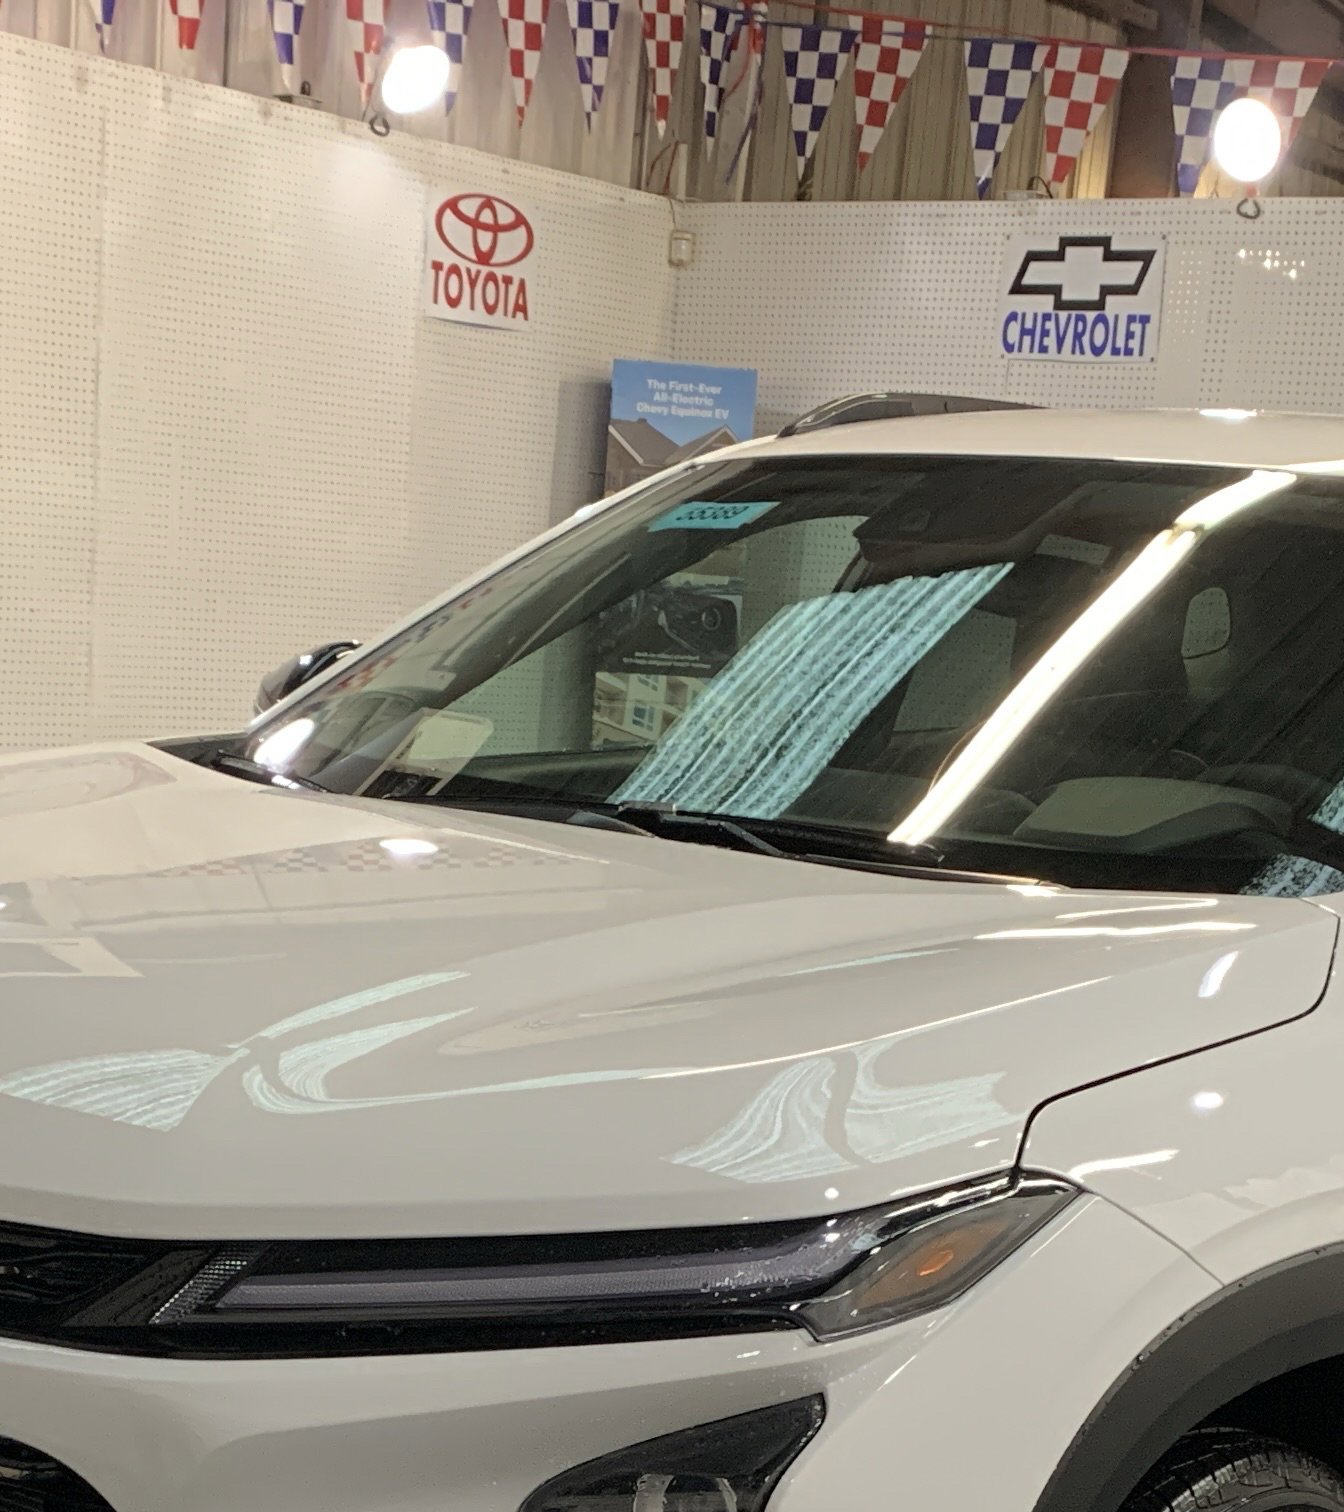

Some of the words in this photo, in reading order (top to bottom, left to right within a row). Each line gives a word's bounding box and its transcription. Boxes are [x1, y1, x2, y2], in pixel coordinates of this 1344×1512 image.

[430, 259, 529, 322] TOYOTA
[1001, 311, 1152, 359] CHEVROLET
[647, 379, 667, 390] The
[714, 407, 730, 420] EV
